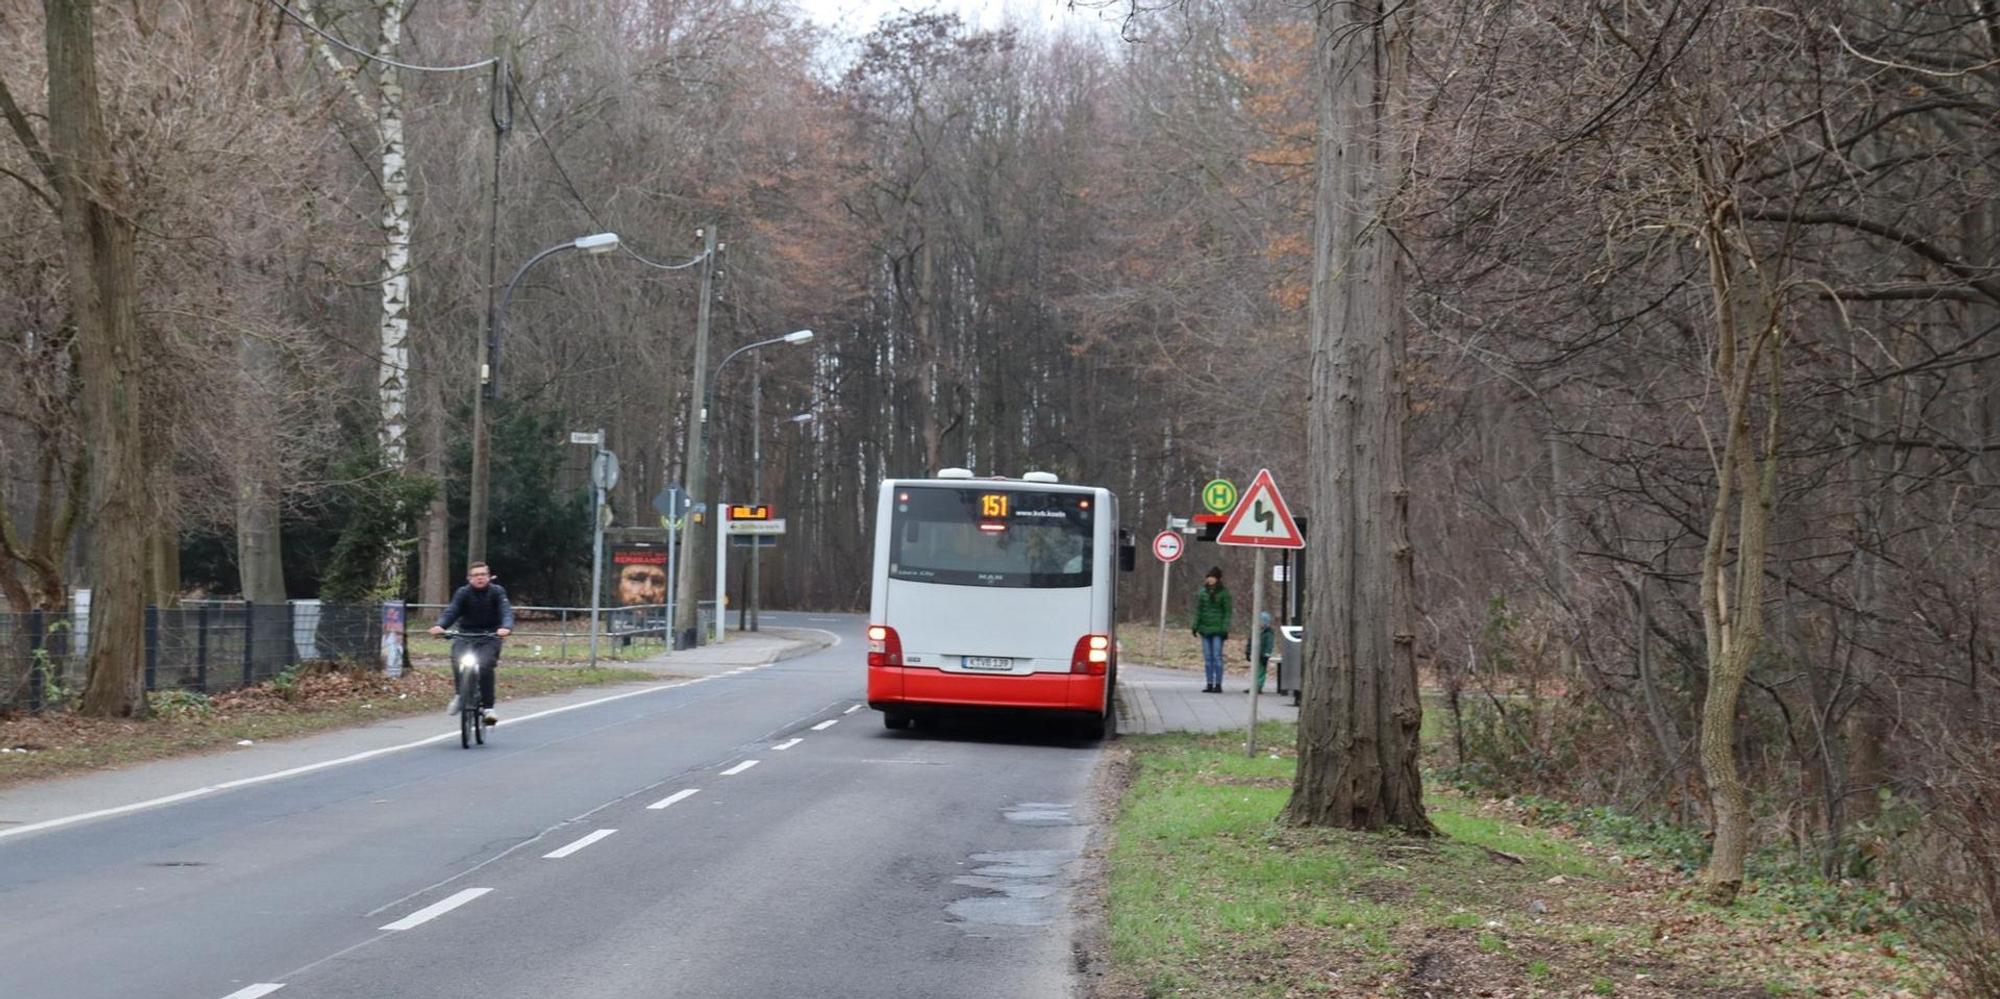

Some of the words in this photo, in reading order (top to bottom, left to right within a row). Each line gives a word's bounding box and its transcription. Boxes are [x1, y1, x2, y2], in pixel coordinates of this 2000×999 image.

[1213, 487, 1227, 505] H
[982, 494, 1007, 517] 151
[1015, 510, 1066, 518] www.kvb.koeln
